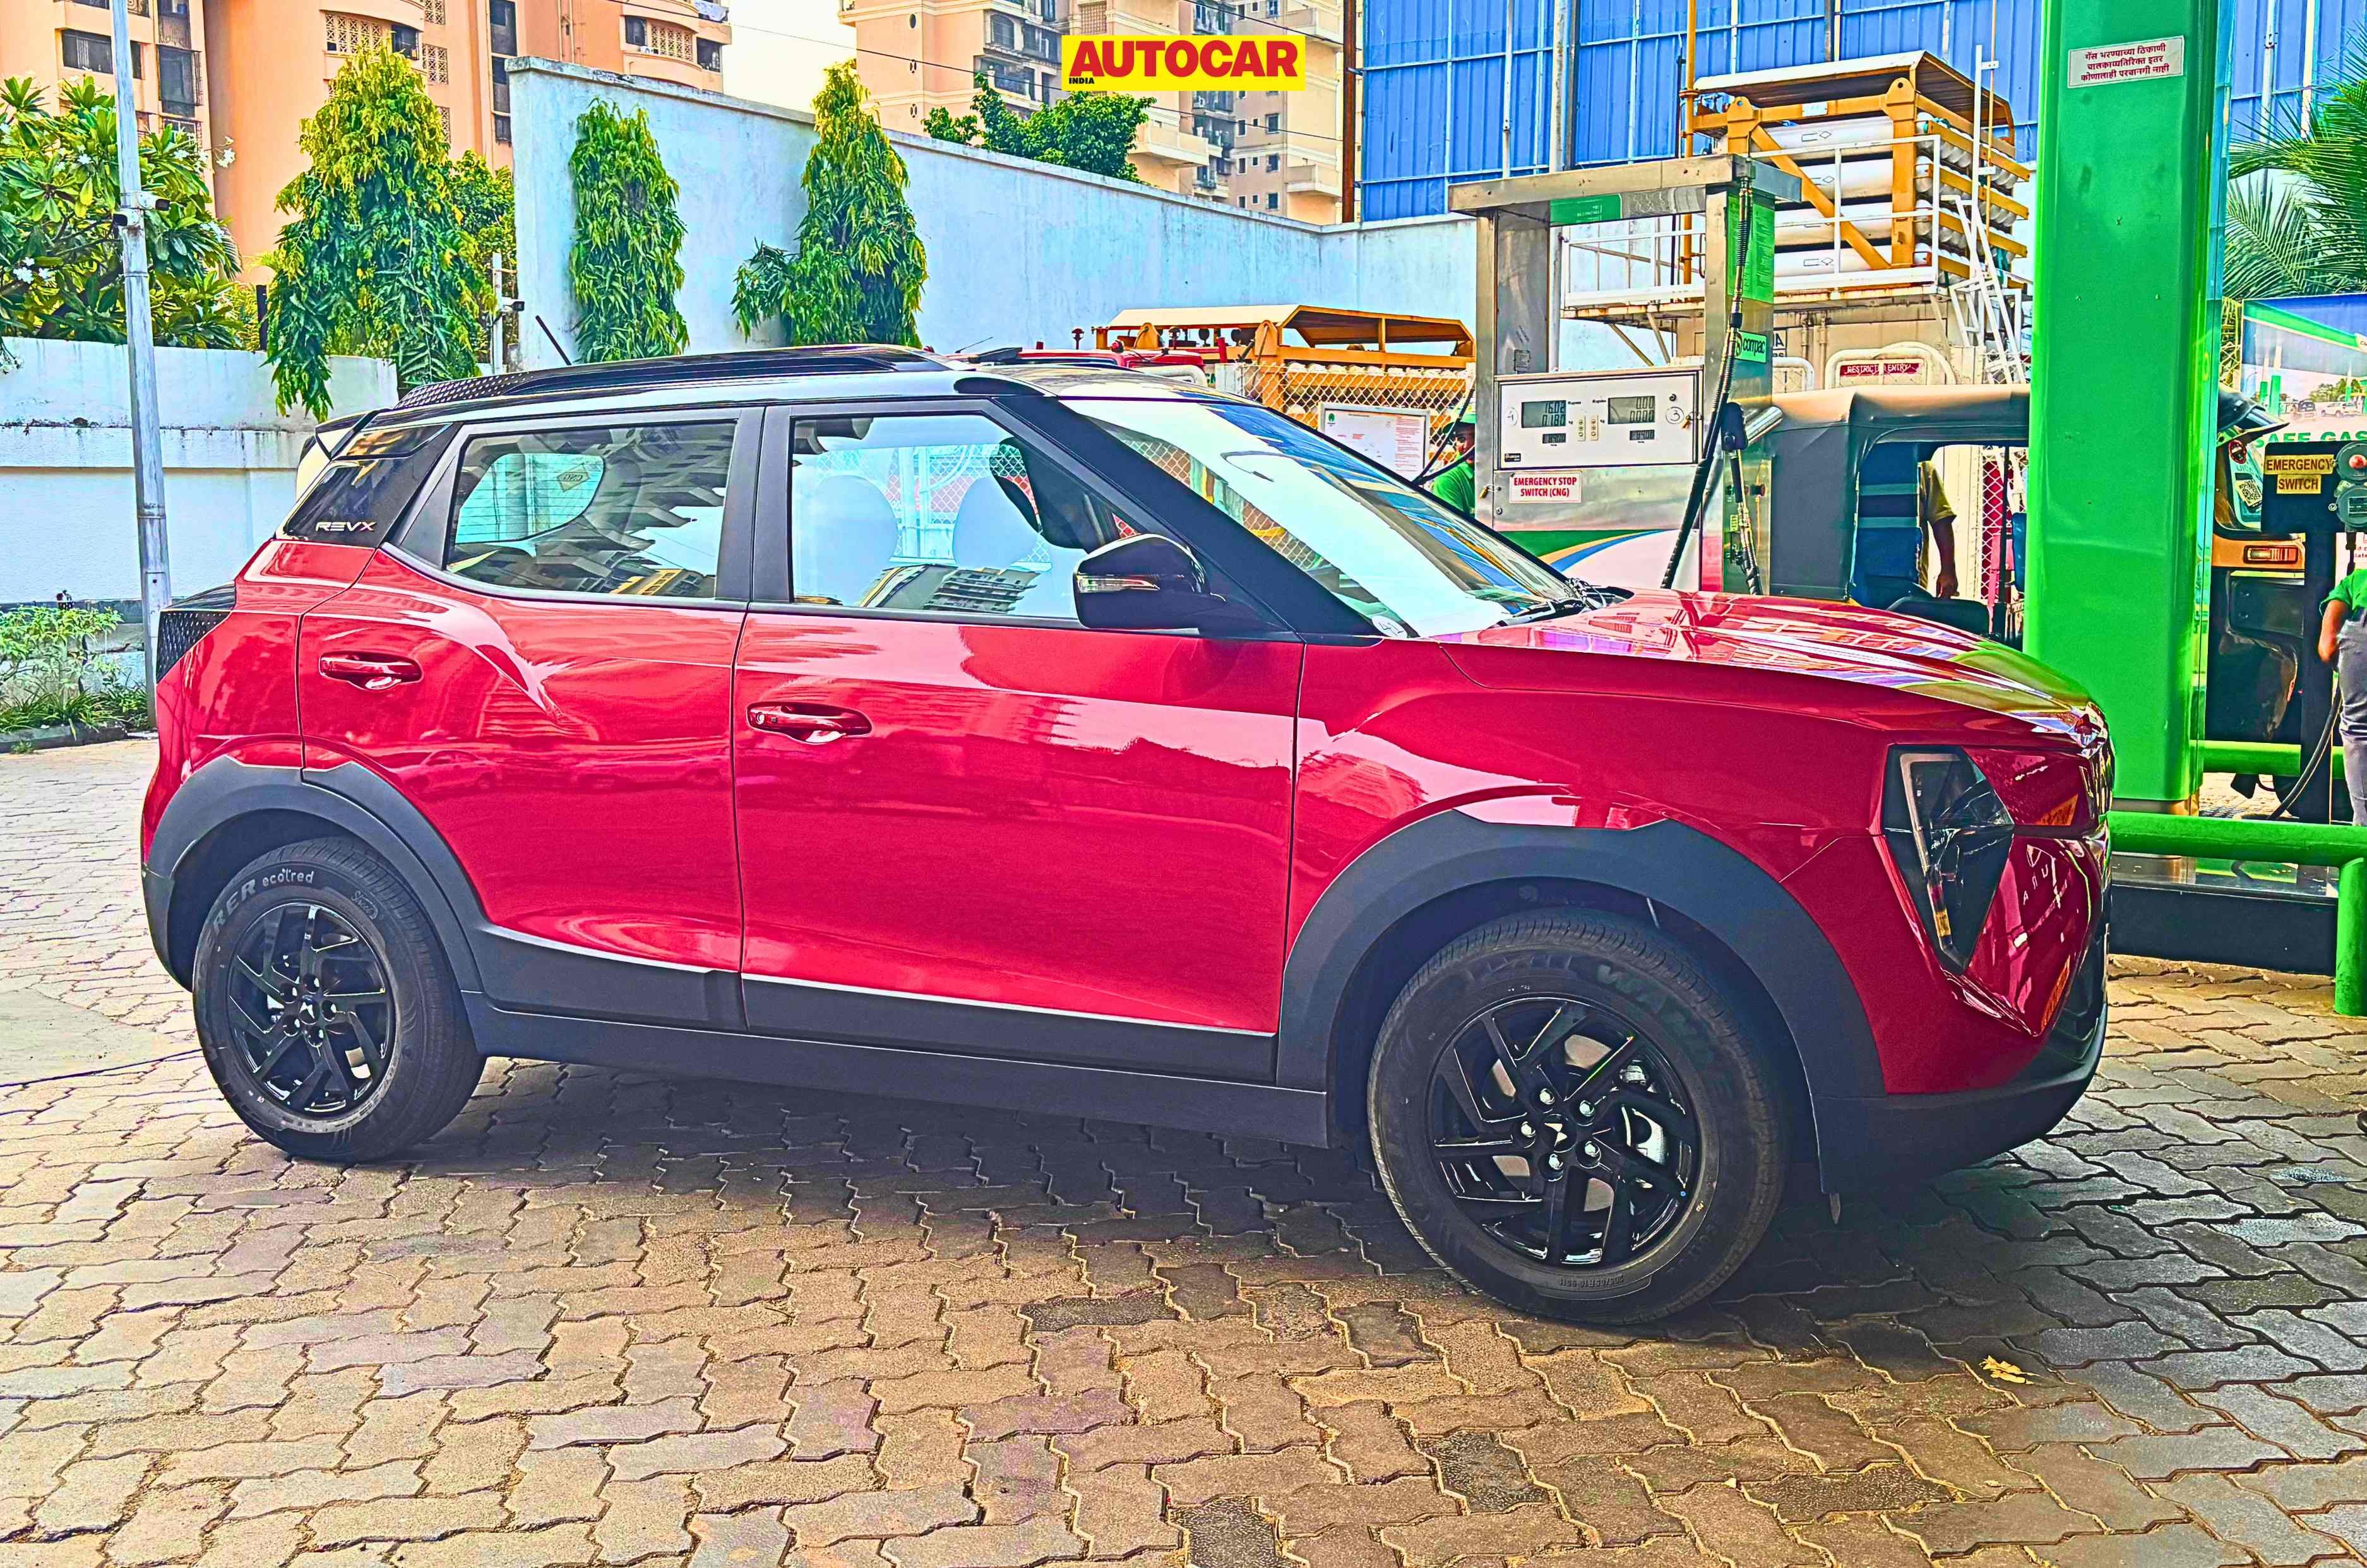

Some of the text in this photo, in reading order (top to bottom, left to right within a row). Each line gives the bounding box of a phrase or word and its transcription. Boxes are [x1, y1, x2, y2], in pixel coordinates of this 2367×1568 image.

[2085, 52, 2097, 61] गॅस
[2138, 43, 2166, 54] ठिकाणी
[2148, 56, 2163, 64] इतर
[2081, 63, 2169, 81] कोणालाही परवानगी नाही
[2267, 458, 2332, 470] EMERGENCY
[1514, 477, 1577, 485] EMERGENCY STOP
[2279, 478, 2318, 490] SWITCH
[1549, 488, 1570, 497] (CNG)
[316, 522, 376, 532] REVX
